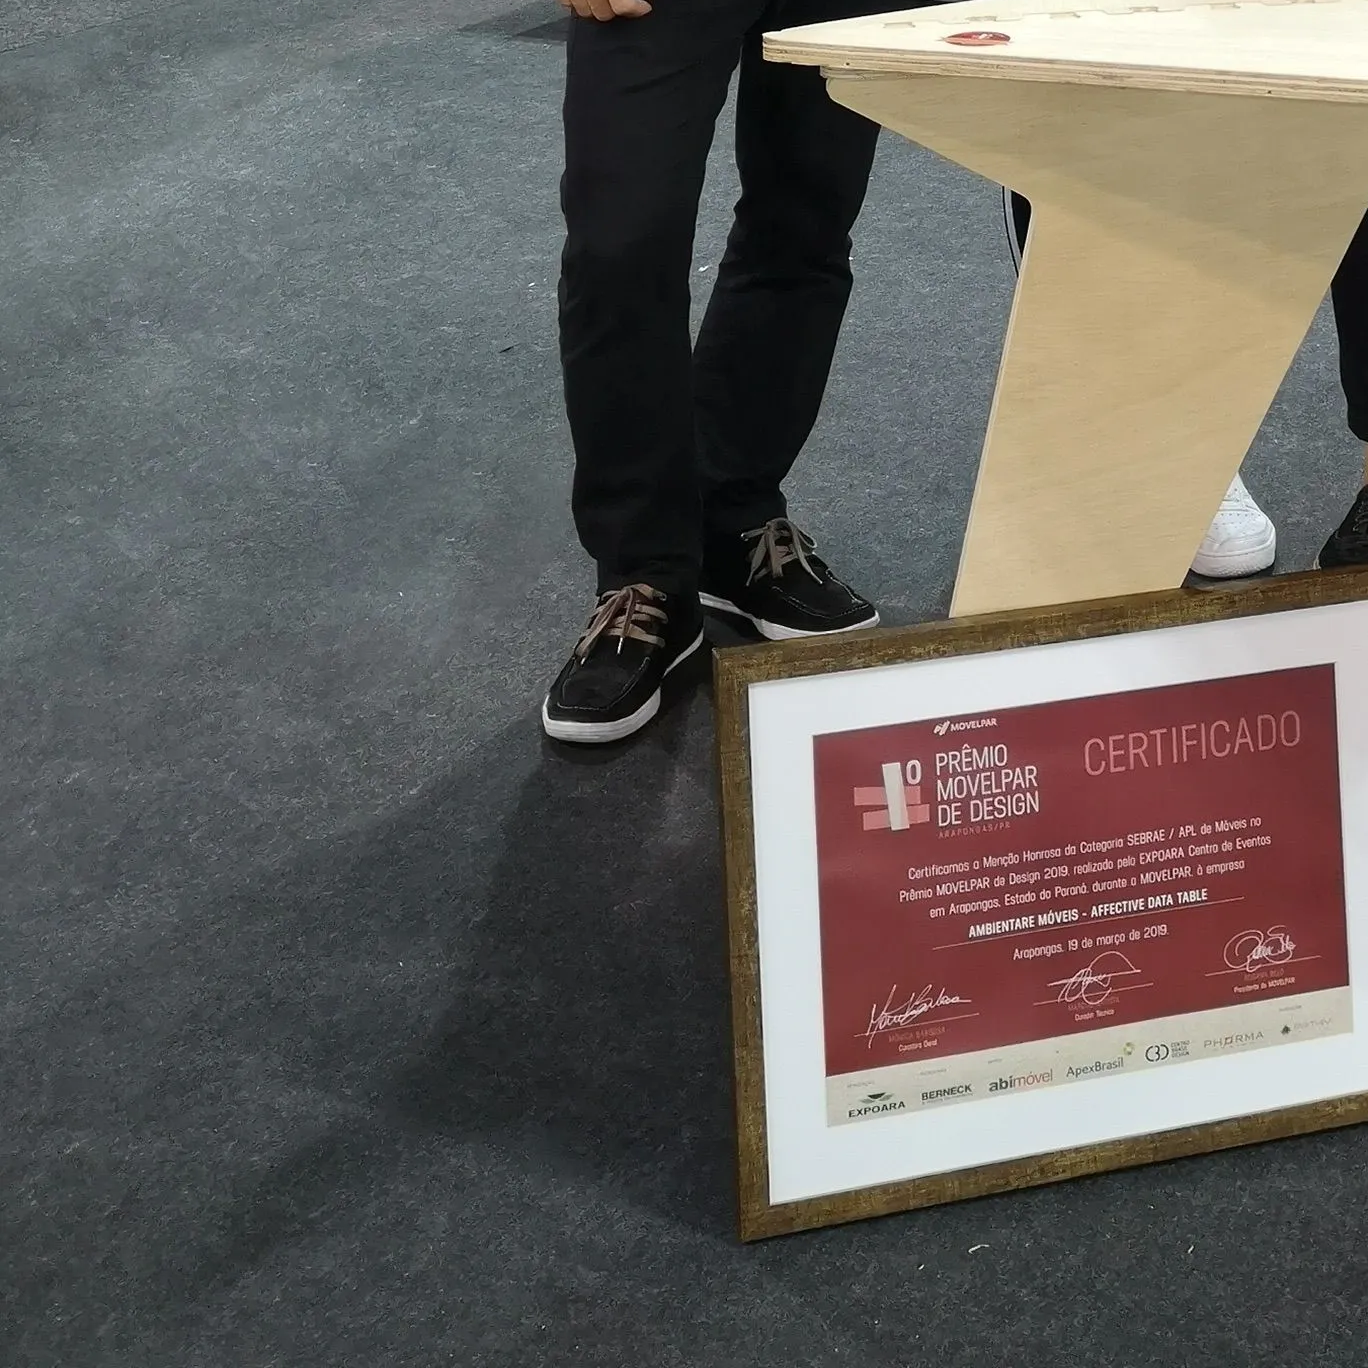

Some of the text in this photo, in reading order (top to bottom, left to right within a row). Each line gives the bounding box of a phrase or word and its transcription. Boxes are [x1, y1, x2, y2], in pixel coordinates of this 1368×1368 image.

[949, 717, 997, 732] MOVELPAR
[1083, 708, 1301, 777] CERTIFICADO
[935, 738, 1007, 775] PRÊMIO
[936, 764, 1038, 801] MOVELPAR
[937, 790, 1039, 827] DE DESIGN
[899, 885, 932, 903] Prêmio
[935, 876, 990, 896] MOVELPAR
[993, 874, 1005, 887] de
[1008, 868, 1040, 887] Design
[1073, 857, 1113, 875] realizado
[1117, 854, 1135, 869] pelo
[1139, 846, 1184, 864] EXPOARA
[1188, 841, 1218, 857] Centro
[1221, 839, 1233, 851] de
[1235, 832, 1271, 849] Eventos
[908, 858, 969, 880] Certificamos
[972, 859, 979, 870] a
[983, 851, 1019, 870] Menção
[1023, 844, 1060, 862] Honrosa
[1064, 842, 1075, 856] da
[1079, 835, 1123, 855] Categoria
[1127, 828, 1165, 846] SEBRAE
[1178, 824, 1196, 838] APL
[1200, 822, 1212, 834] de
[1250, 816, 1261, 827] no
[929, 906, 945, 918] em
[1004, 889, 1036, 906] Estado
[1039, 887, 1051, 900] do
[1092, 875, 1127, 892] durante
[1206, 859, 1244, 876] empresa
[968, 915, 1035, 938] AMBIENTARE
[1037, 905, 1078, 927] MÓVEIS
[1090, 897, 1144, 918] AFFECTIVE
[1147, 893, 1173, 909] DATA
[1176, 887, 1208, 904] TABLE
[1067, 938, 1078, 951] 19
[1081, 936, 1092, 949] de
[1096, 933, 1125, 948] março
[1128, 928, 1140, 941] de
[1268, 976, 1295, 988] MOVELPAR
[848, 1100, 905, 1118] EXPOARA
[921, 1083, 972, 1101] BERNECK
[988, 1067, 1053, 1092] abimóvel
[1065, 1056, 1123, 1079] ApexBrasil
